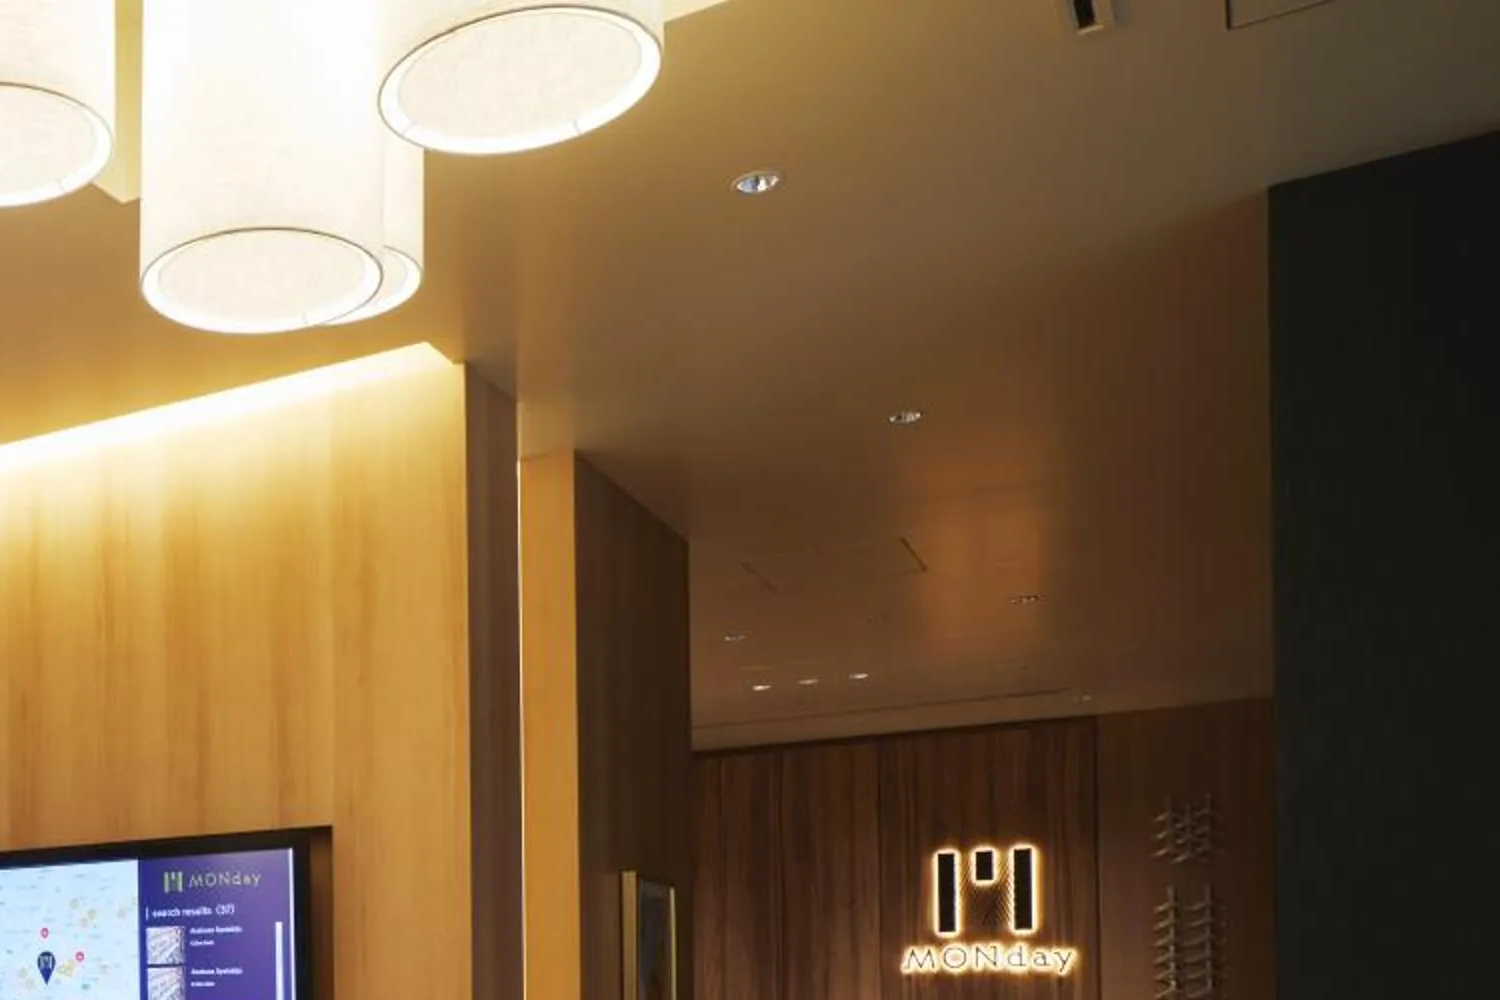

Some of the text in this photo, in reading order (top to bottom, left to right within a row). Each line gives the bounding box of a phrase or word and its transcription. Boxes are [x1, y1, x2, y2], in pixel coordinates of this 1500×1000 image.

[188, 871, 262, 888] MONday
[152, 905, 181, 918] search
[181, 905, 213, 917] results
[903, 944, 1074, 974] MONday
